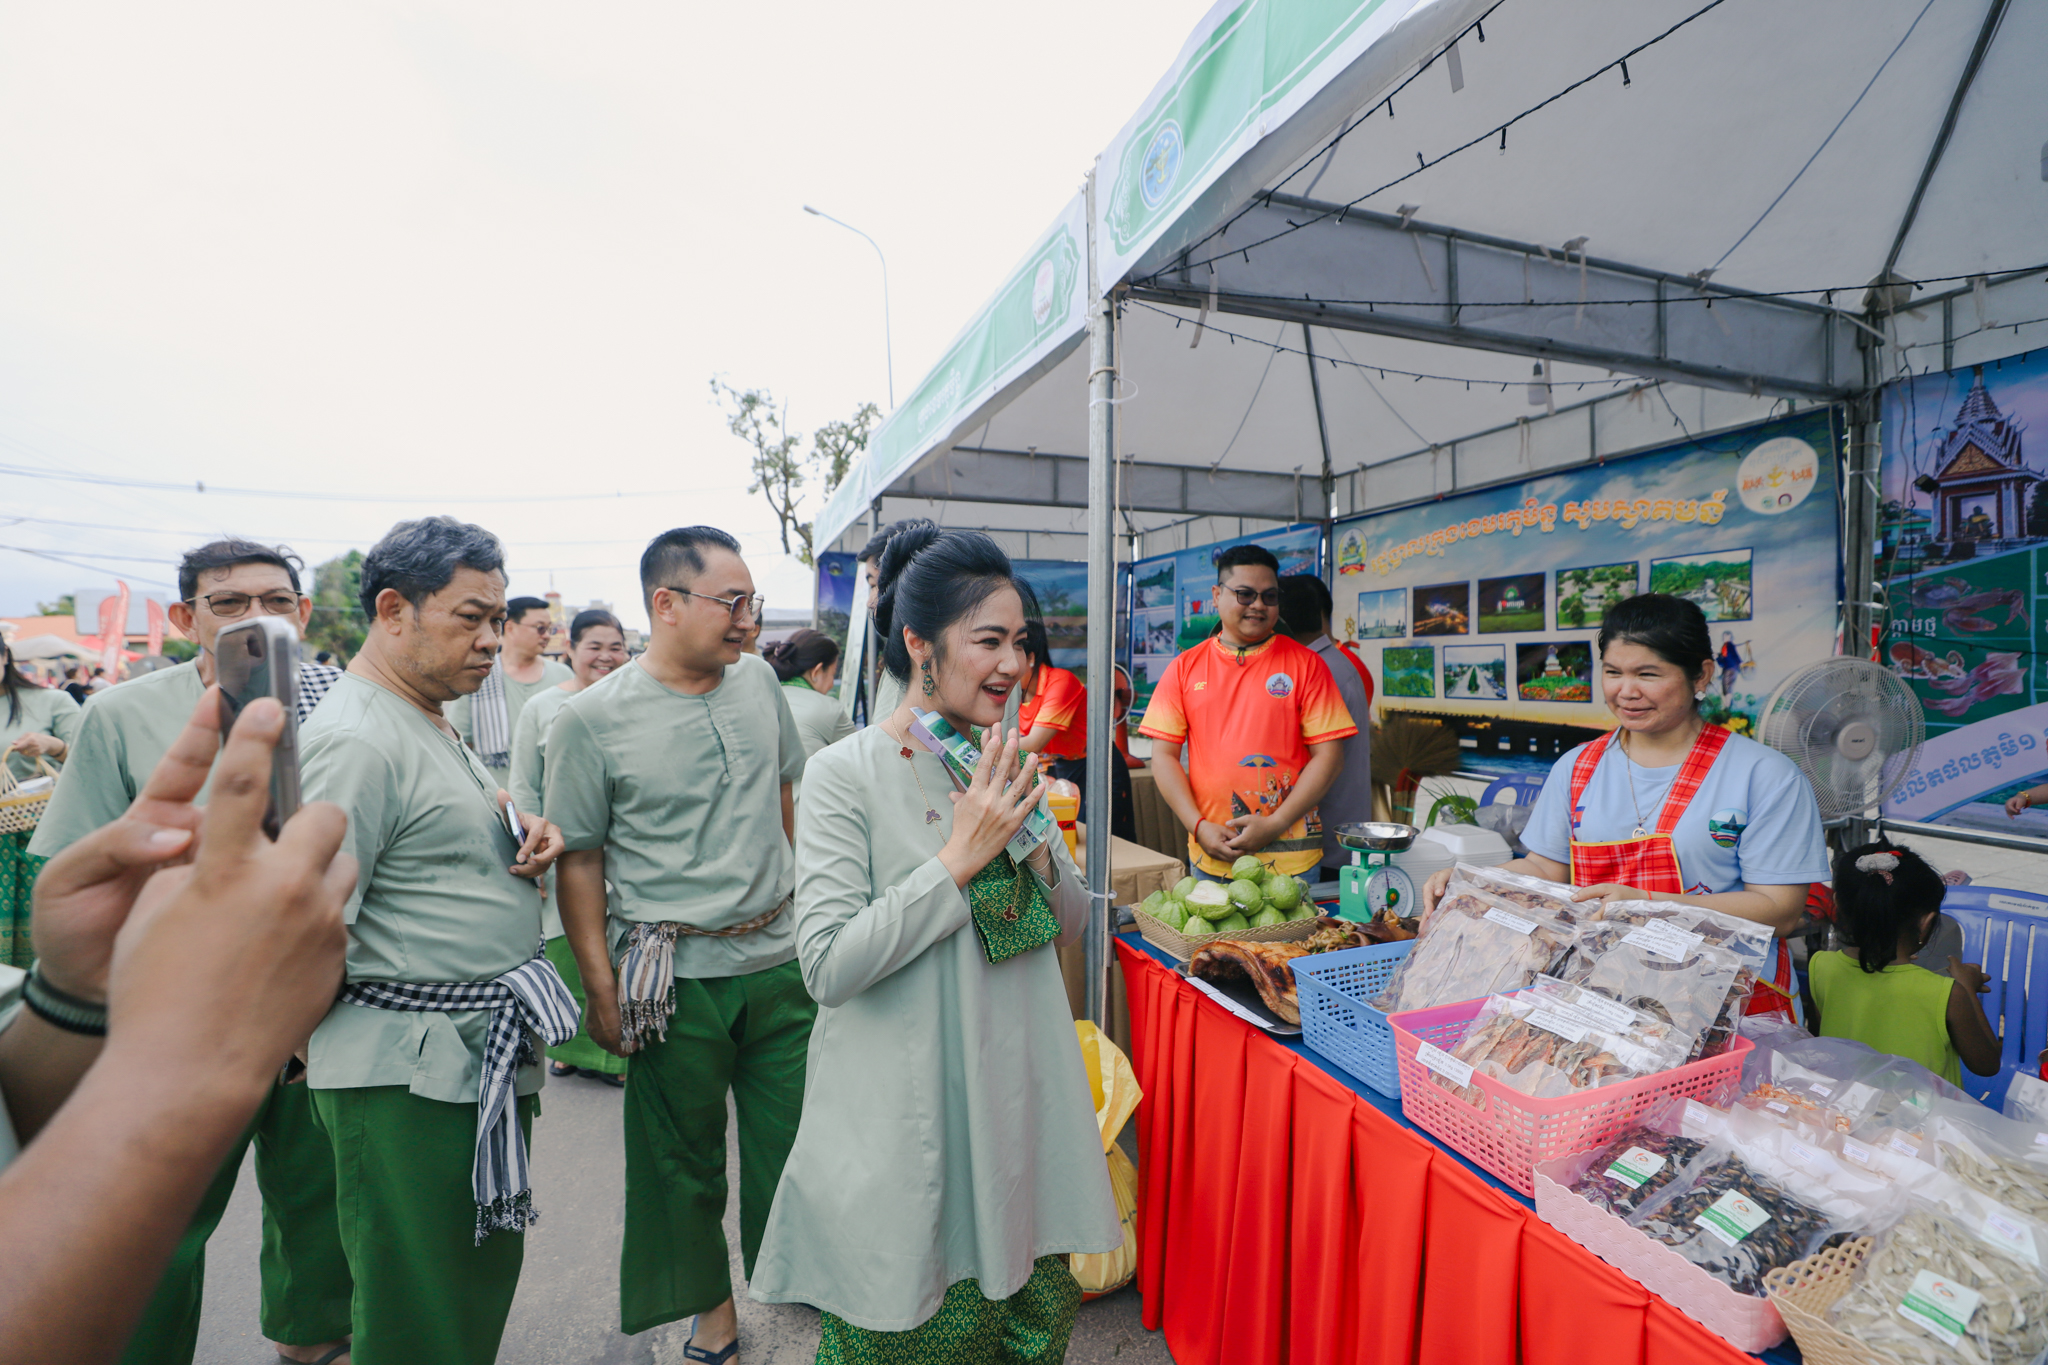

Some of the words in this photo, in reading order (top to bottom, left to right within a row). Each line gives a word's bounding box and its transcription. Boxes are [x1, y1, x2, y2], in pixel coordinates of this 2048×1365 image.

[1562, 487, 1730, 531] សូមស្វាគមន៍
